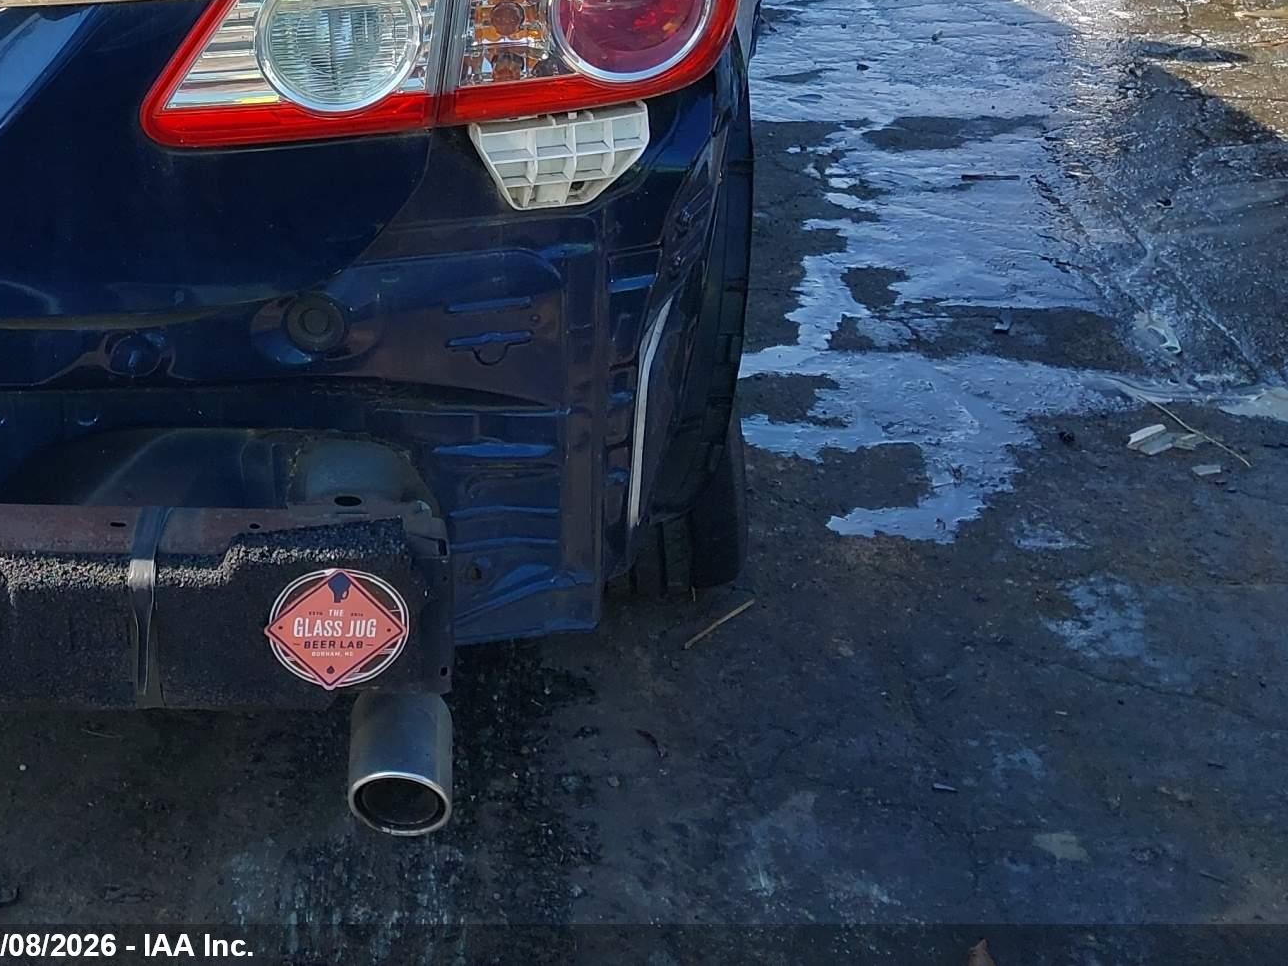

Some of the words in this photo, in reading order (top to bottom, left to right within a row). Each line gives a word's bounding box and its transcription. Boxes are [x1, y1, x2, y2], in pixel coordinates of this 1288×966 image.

[328, 609, 345, 618] THE
[293, 617, 344, 638] GLASS
[345, 618, 377, 638] JUG
[303, 640, 337, 649] BEER
[339, 640, 363, 649] LAB
